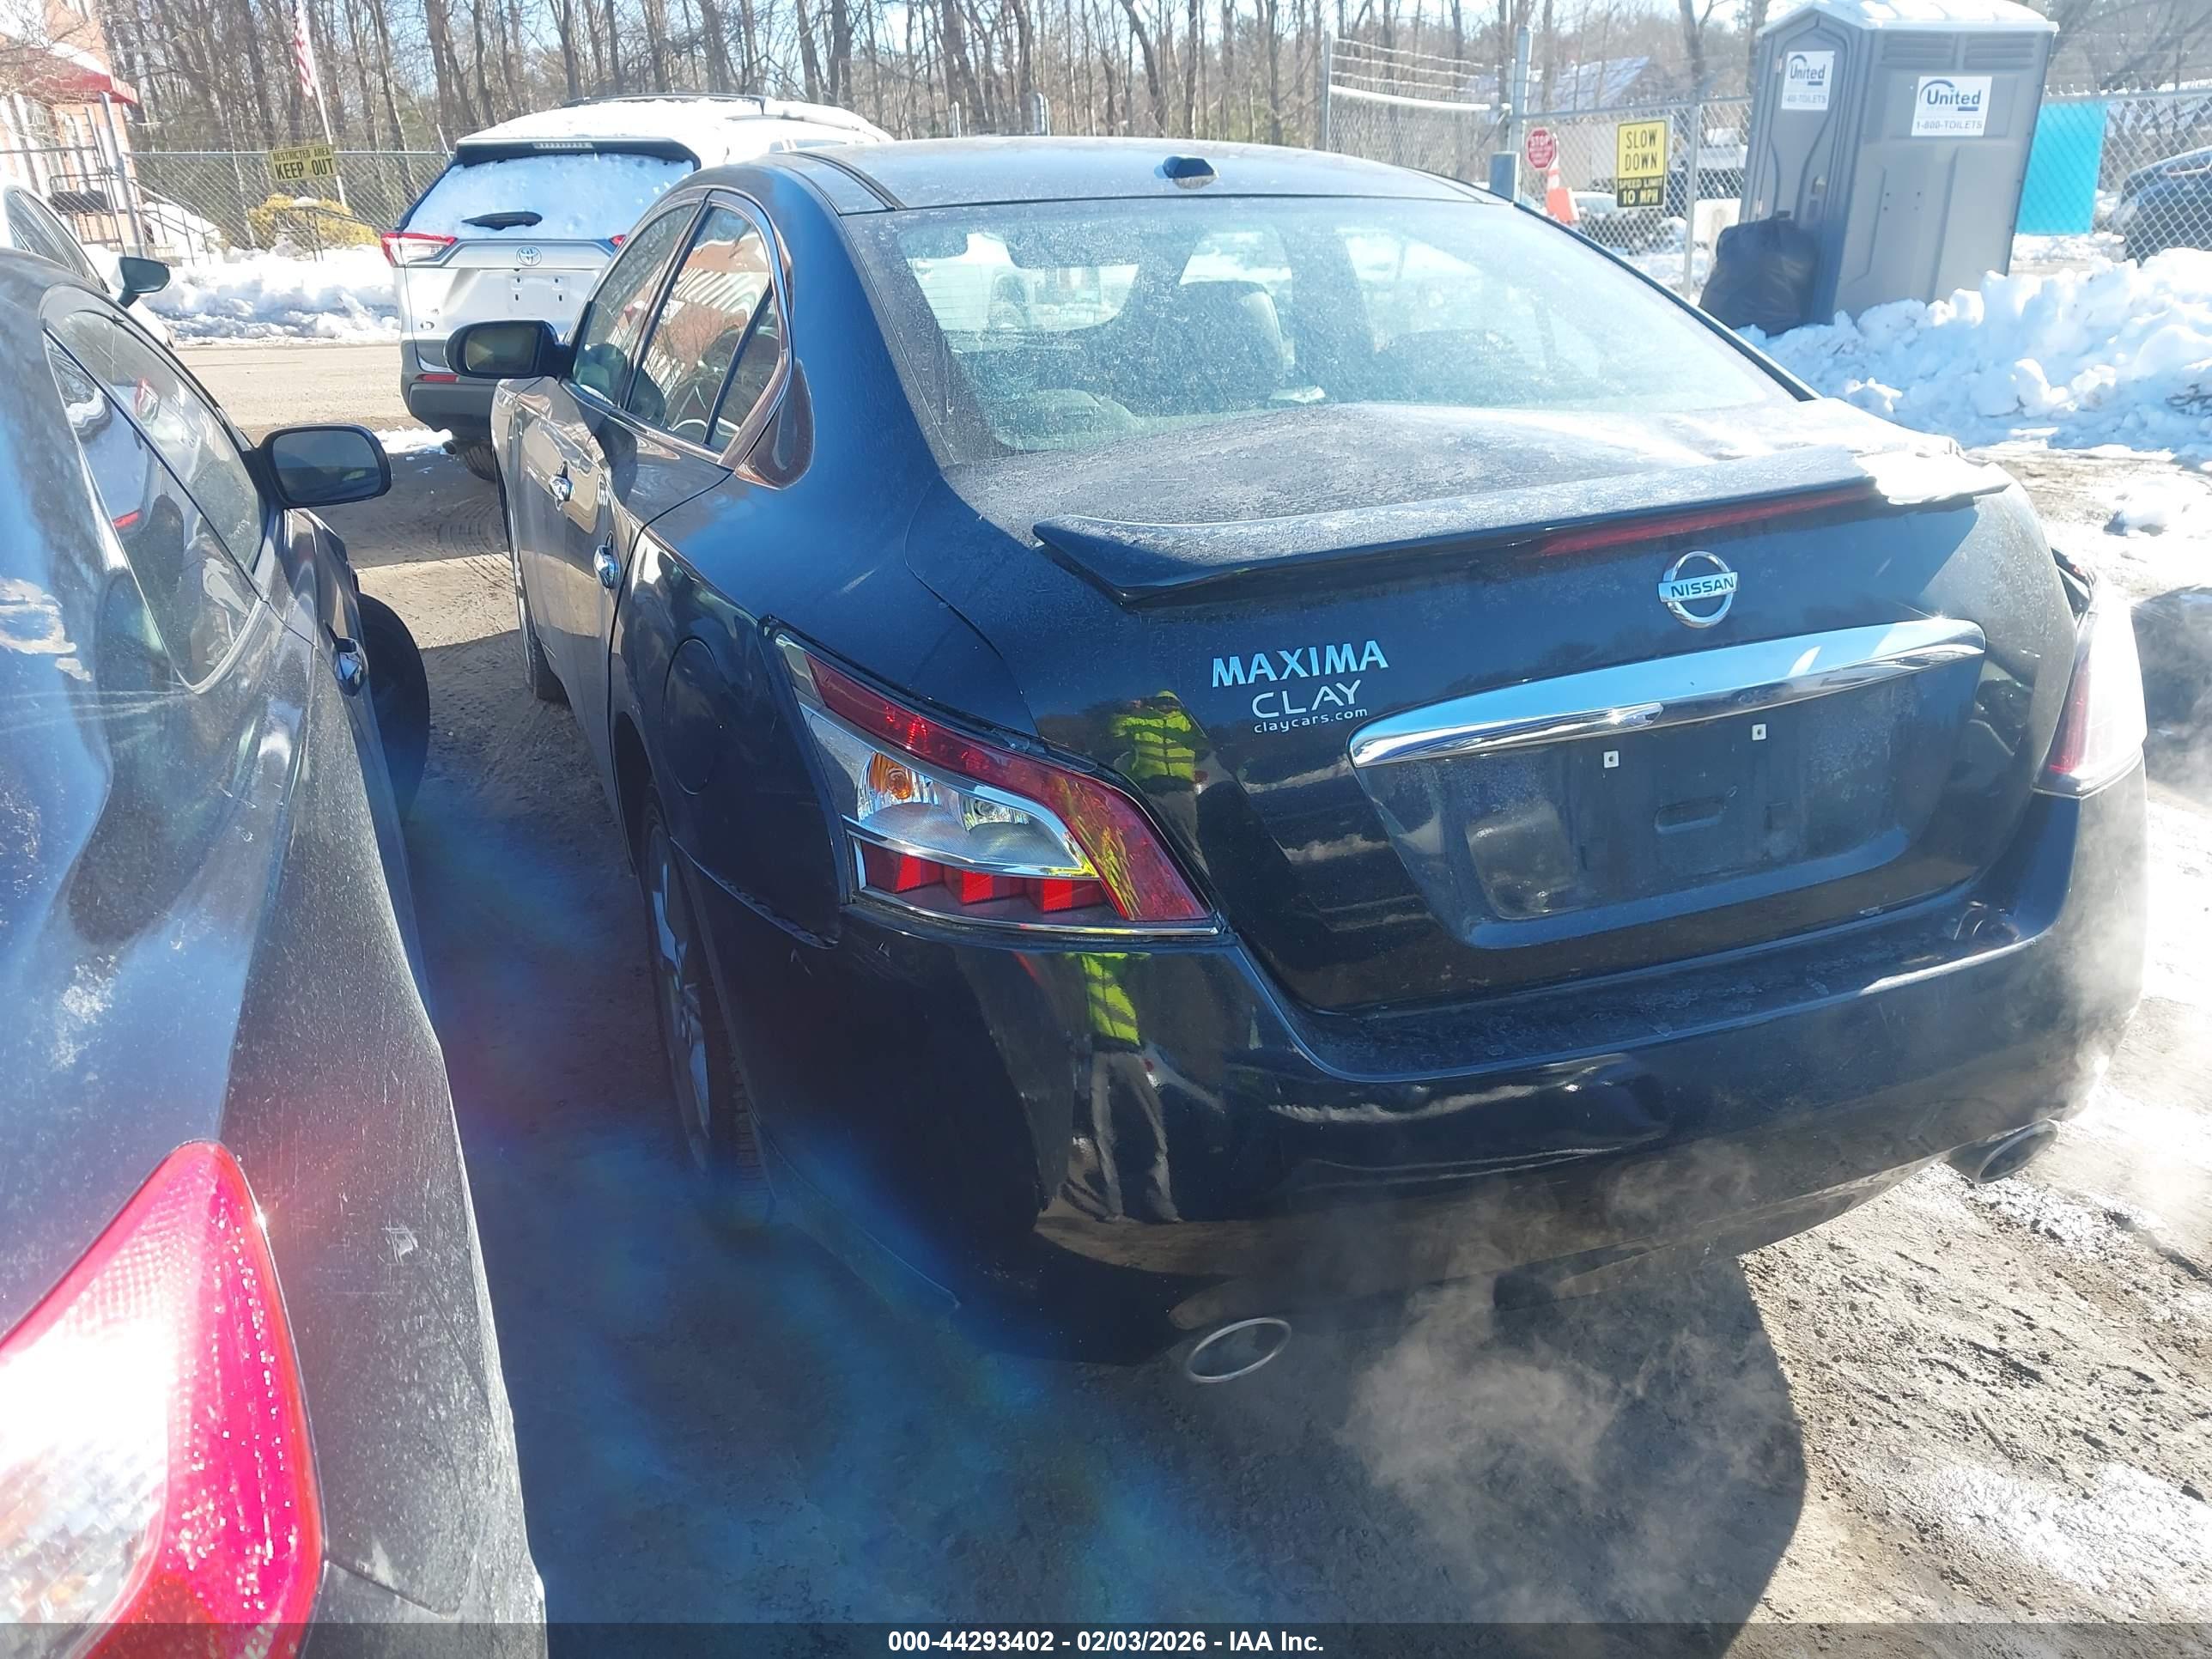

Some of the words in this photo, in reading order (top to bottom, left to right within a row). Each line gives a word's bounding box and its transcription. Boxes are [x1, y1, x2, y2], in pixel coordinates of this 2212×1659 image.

[1790, 64, 1826, 79] United
[1927, 88, 1981, 105] United
[1916, 120, 1983, 130] 1-800-TOILETS
[1530, 134, 1549, 147] STOP
[1626, 131, 1657, 149] SLOW
[273, 150, 310, 161] RESTRICTED
[314, 148, 330, 157] AREA
[1625, 153, 1658, 171] DOWN
[275, 161, 304, 179] KEEP
[312, 158, 333, 175] OUT
[1623, 190, 1635, 204] 10
[1671, 577, 1735, 598] NISSAN
[1212, 640, 1389, 688] MAXIMA
[1251, 679, 1361, 719] CLAY
[1254, 708, 1368, 733] claycars.com
